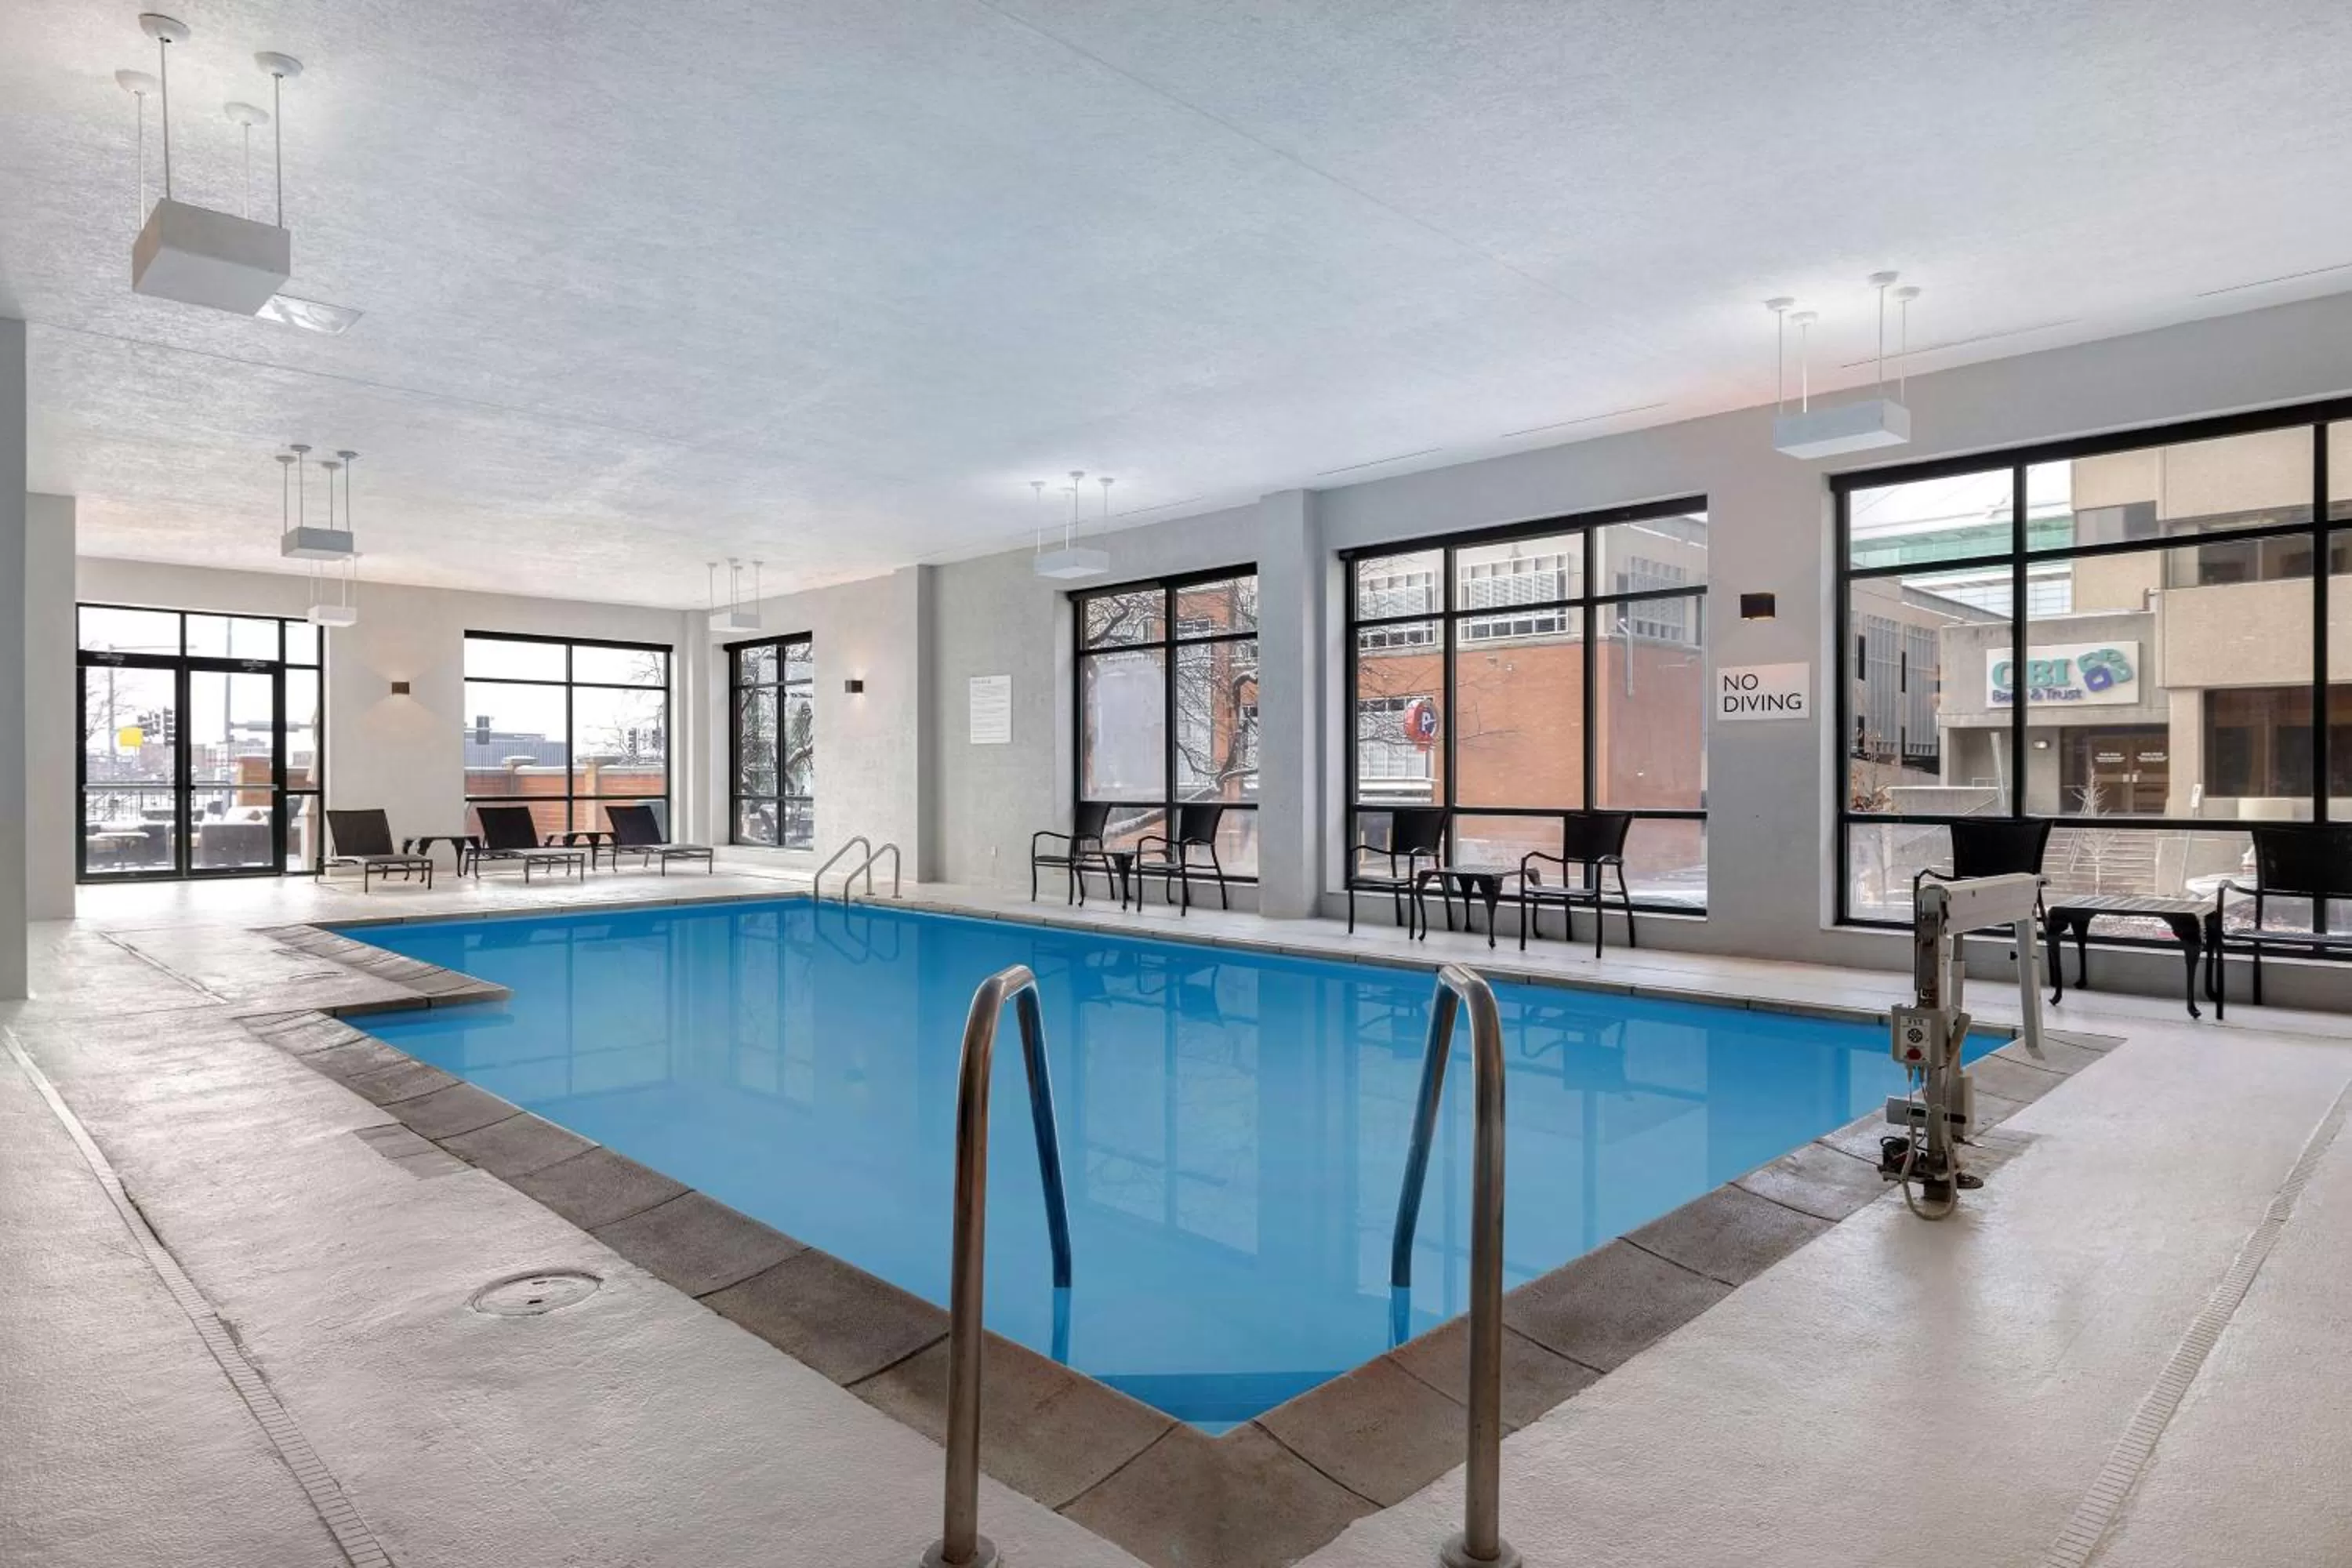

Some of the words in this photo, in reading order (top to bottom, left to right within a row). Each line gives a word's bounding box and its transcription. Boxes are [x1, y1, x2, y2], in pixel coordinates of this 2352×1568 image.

[1724, 673, 1759, 691] NO
[1992, 659, 2072, 689] CBI
[1724, 692, 1803, 713] DIVING
[2030, 687, 2044, 701] &
[2045, 687, 2083, 700] Trust
